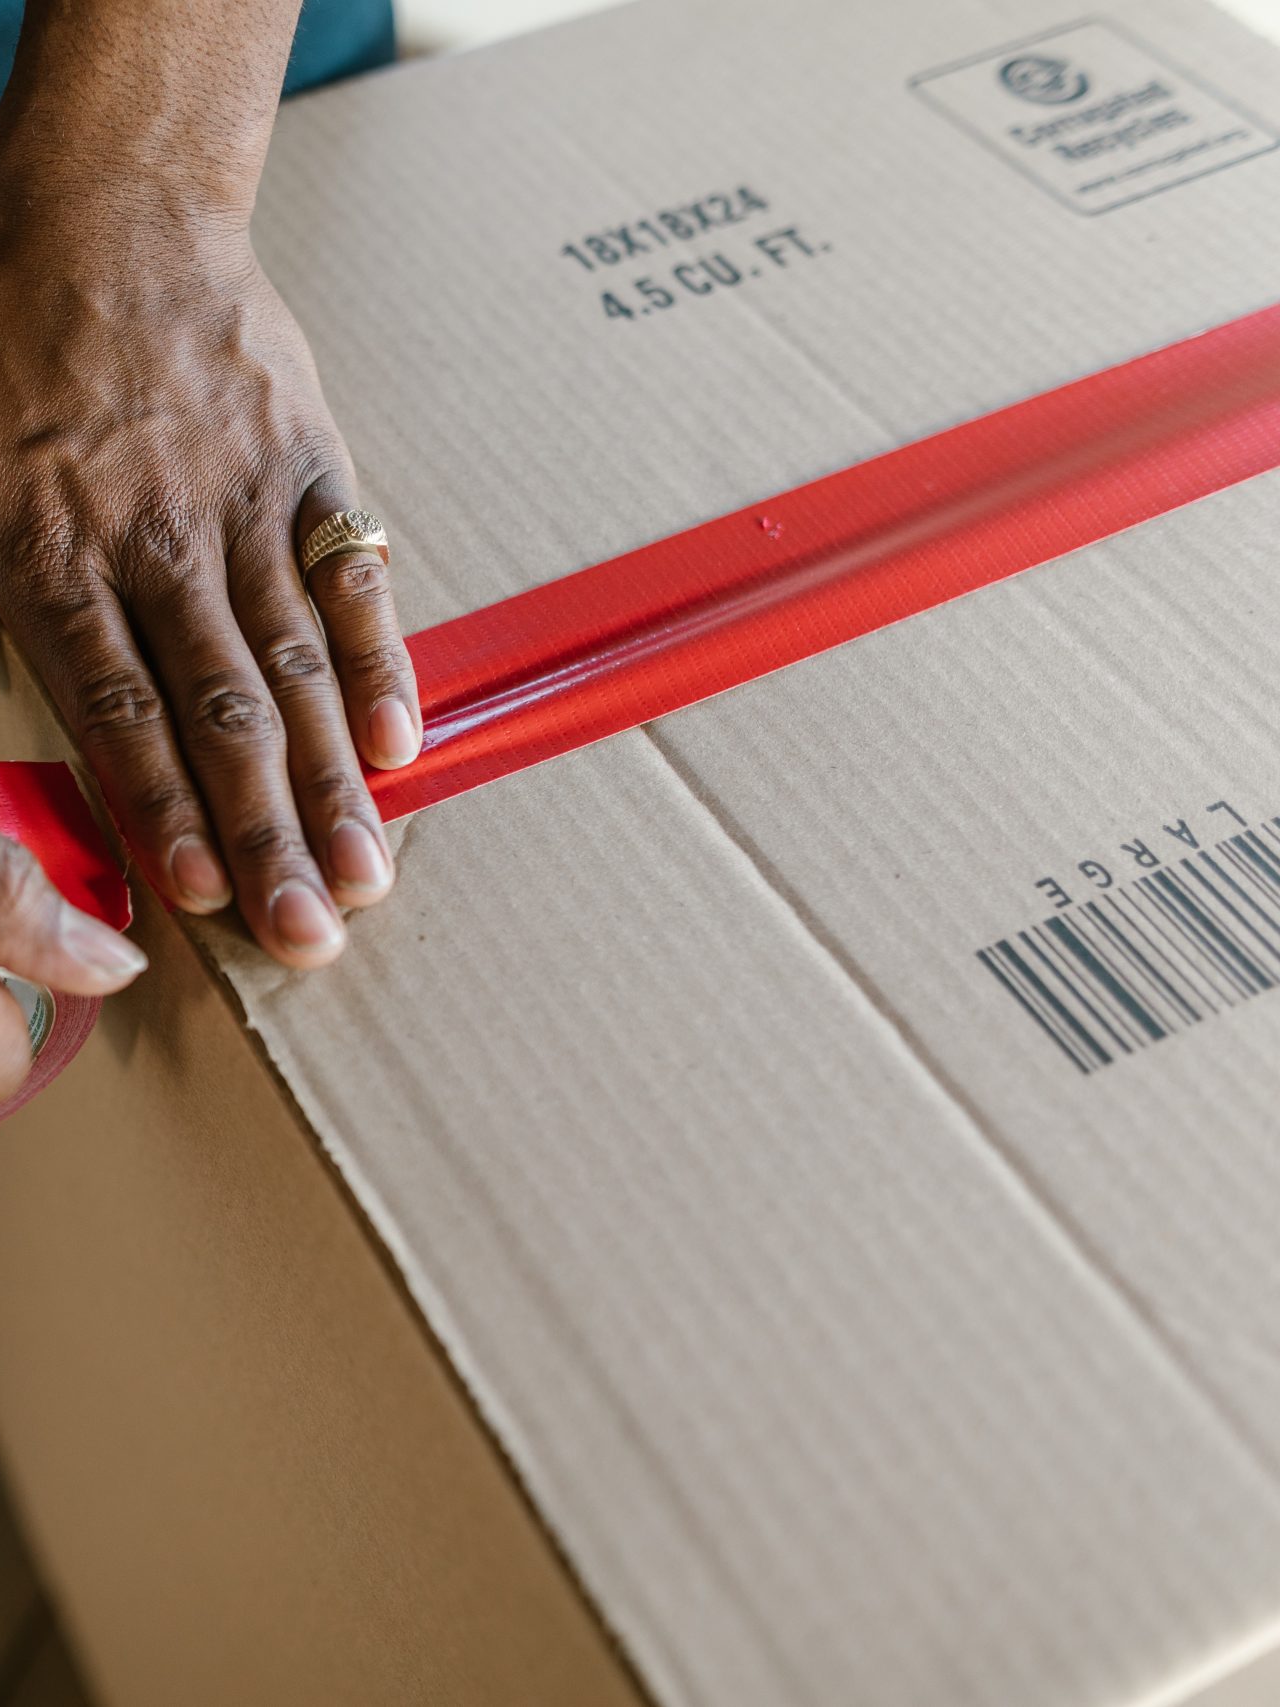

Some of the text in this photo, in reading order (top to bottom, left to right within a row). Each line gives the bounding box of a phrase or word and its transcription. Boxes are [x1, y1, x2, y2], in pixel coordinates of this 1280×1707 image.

[560, 184, 770, 273] 18X18X24
[599, 225, 832, 322] 4.5 CU. FT.
